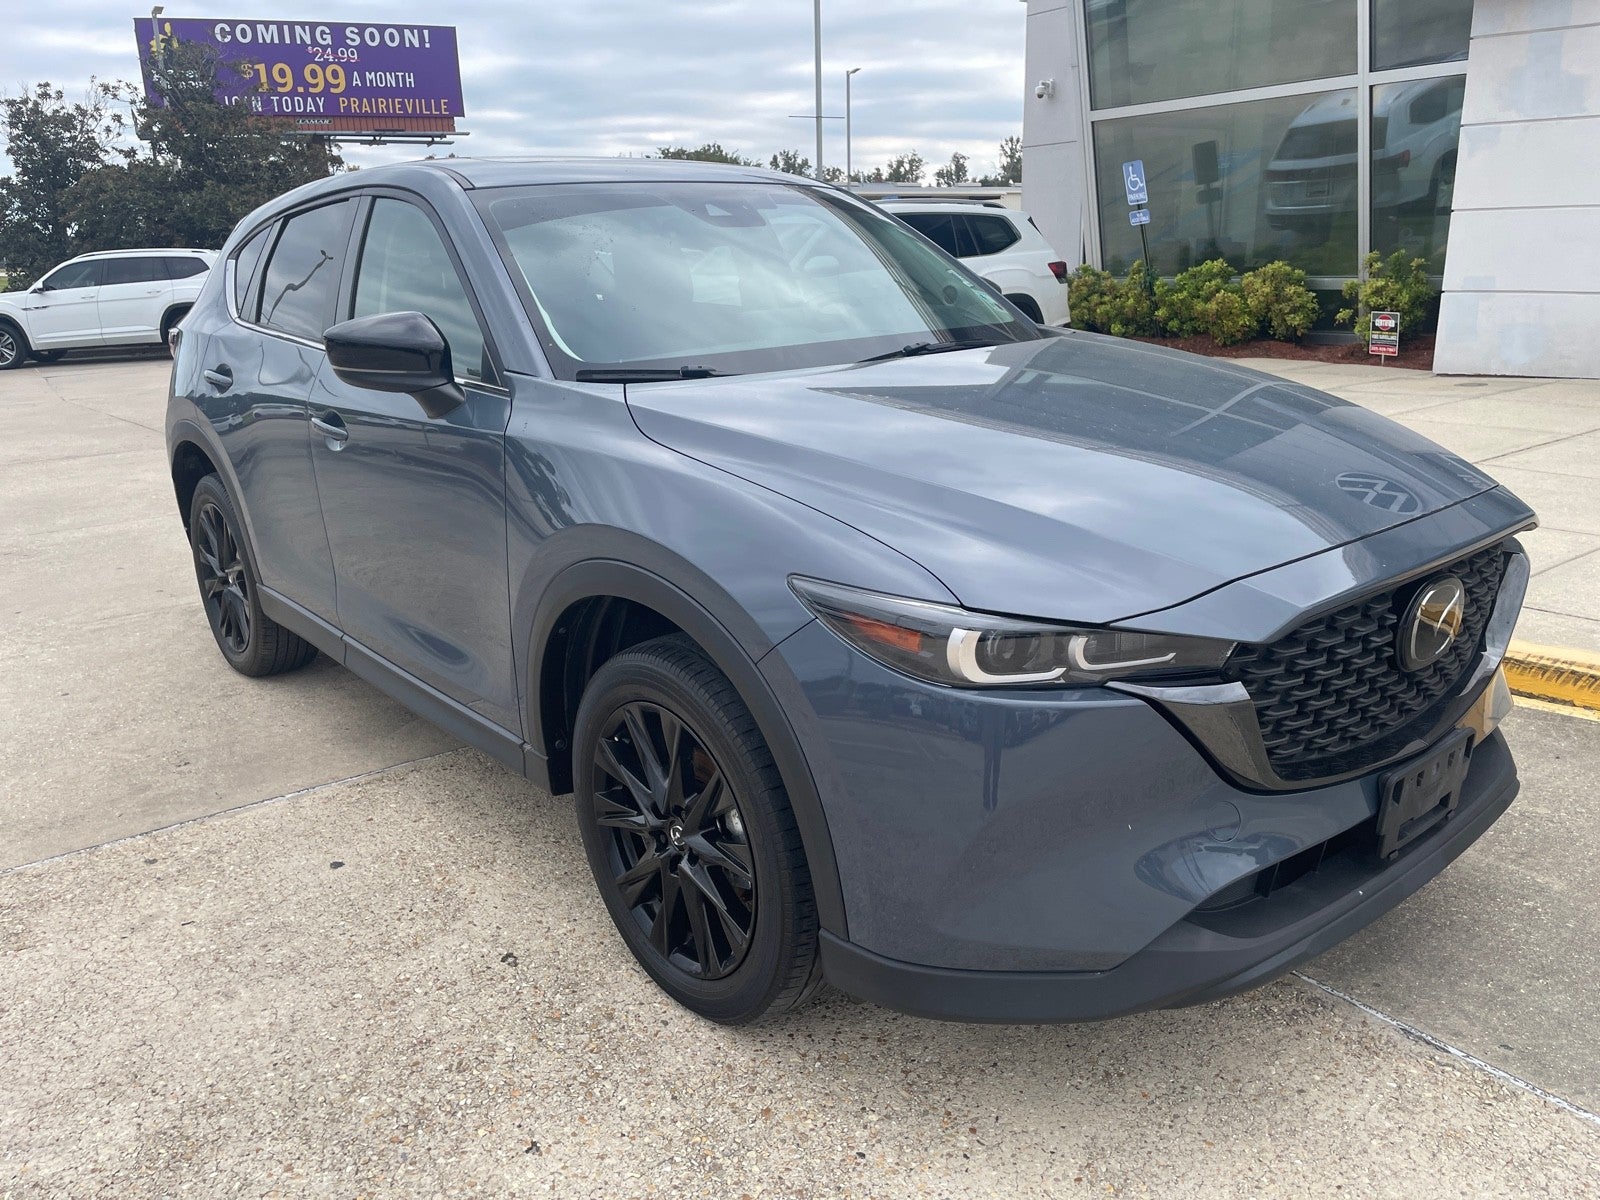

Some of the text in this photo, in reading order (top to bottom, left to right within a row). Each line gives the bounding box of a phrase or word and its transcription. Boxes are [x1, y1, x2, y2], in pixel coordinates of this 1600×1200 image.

[214, 22, 431, 48] COMING SOON!
[307, 45, 358, 63] $24.99
[241, 62, 415, 94] $19.99 A MONTH
[270, 96, 325, 113] TODAY
[338, 97, 450, 115] PRAIRIEVILLE
